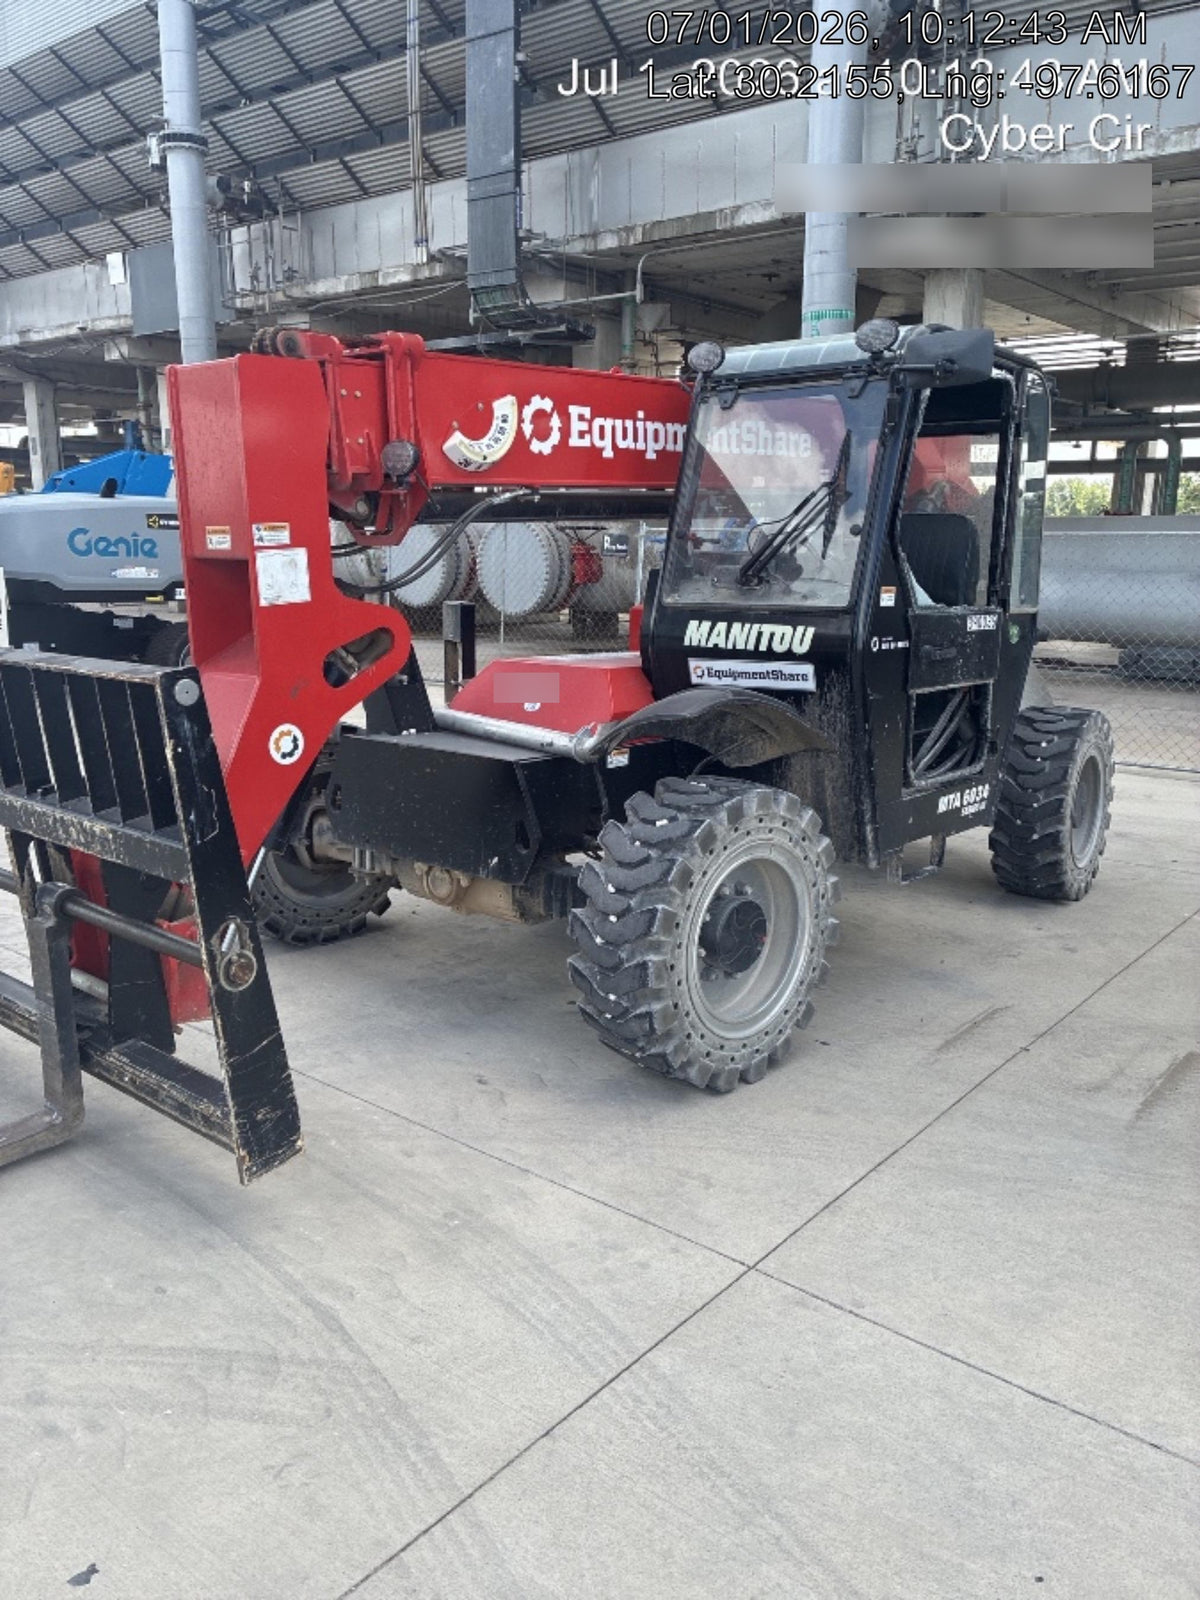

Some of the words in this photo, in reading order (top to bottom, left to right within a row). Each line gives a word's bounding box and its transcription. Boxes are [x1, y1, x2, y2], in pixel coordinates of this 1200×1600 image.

[568, 404, 813, 460] EquipmntShare
[67, 527, 159, 559] Genie
[683, 620, 816, 656] MANITOU
[706, 666, 810, 683] EquipmentShare
[937, 791, 962, 815] MTA
